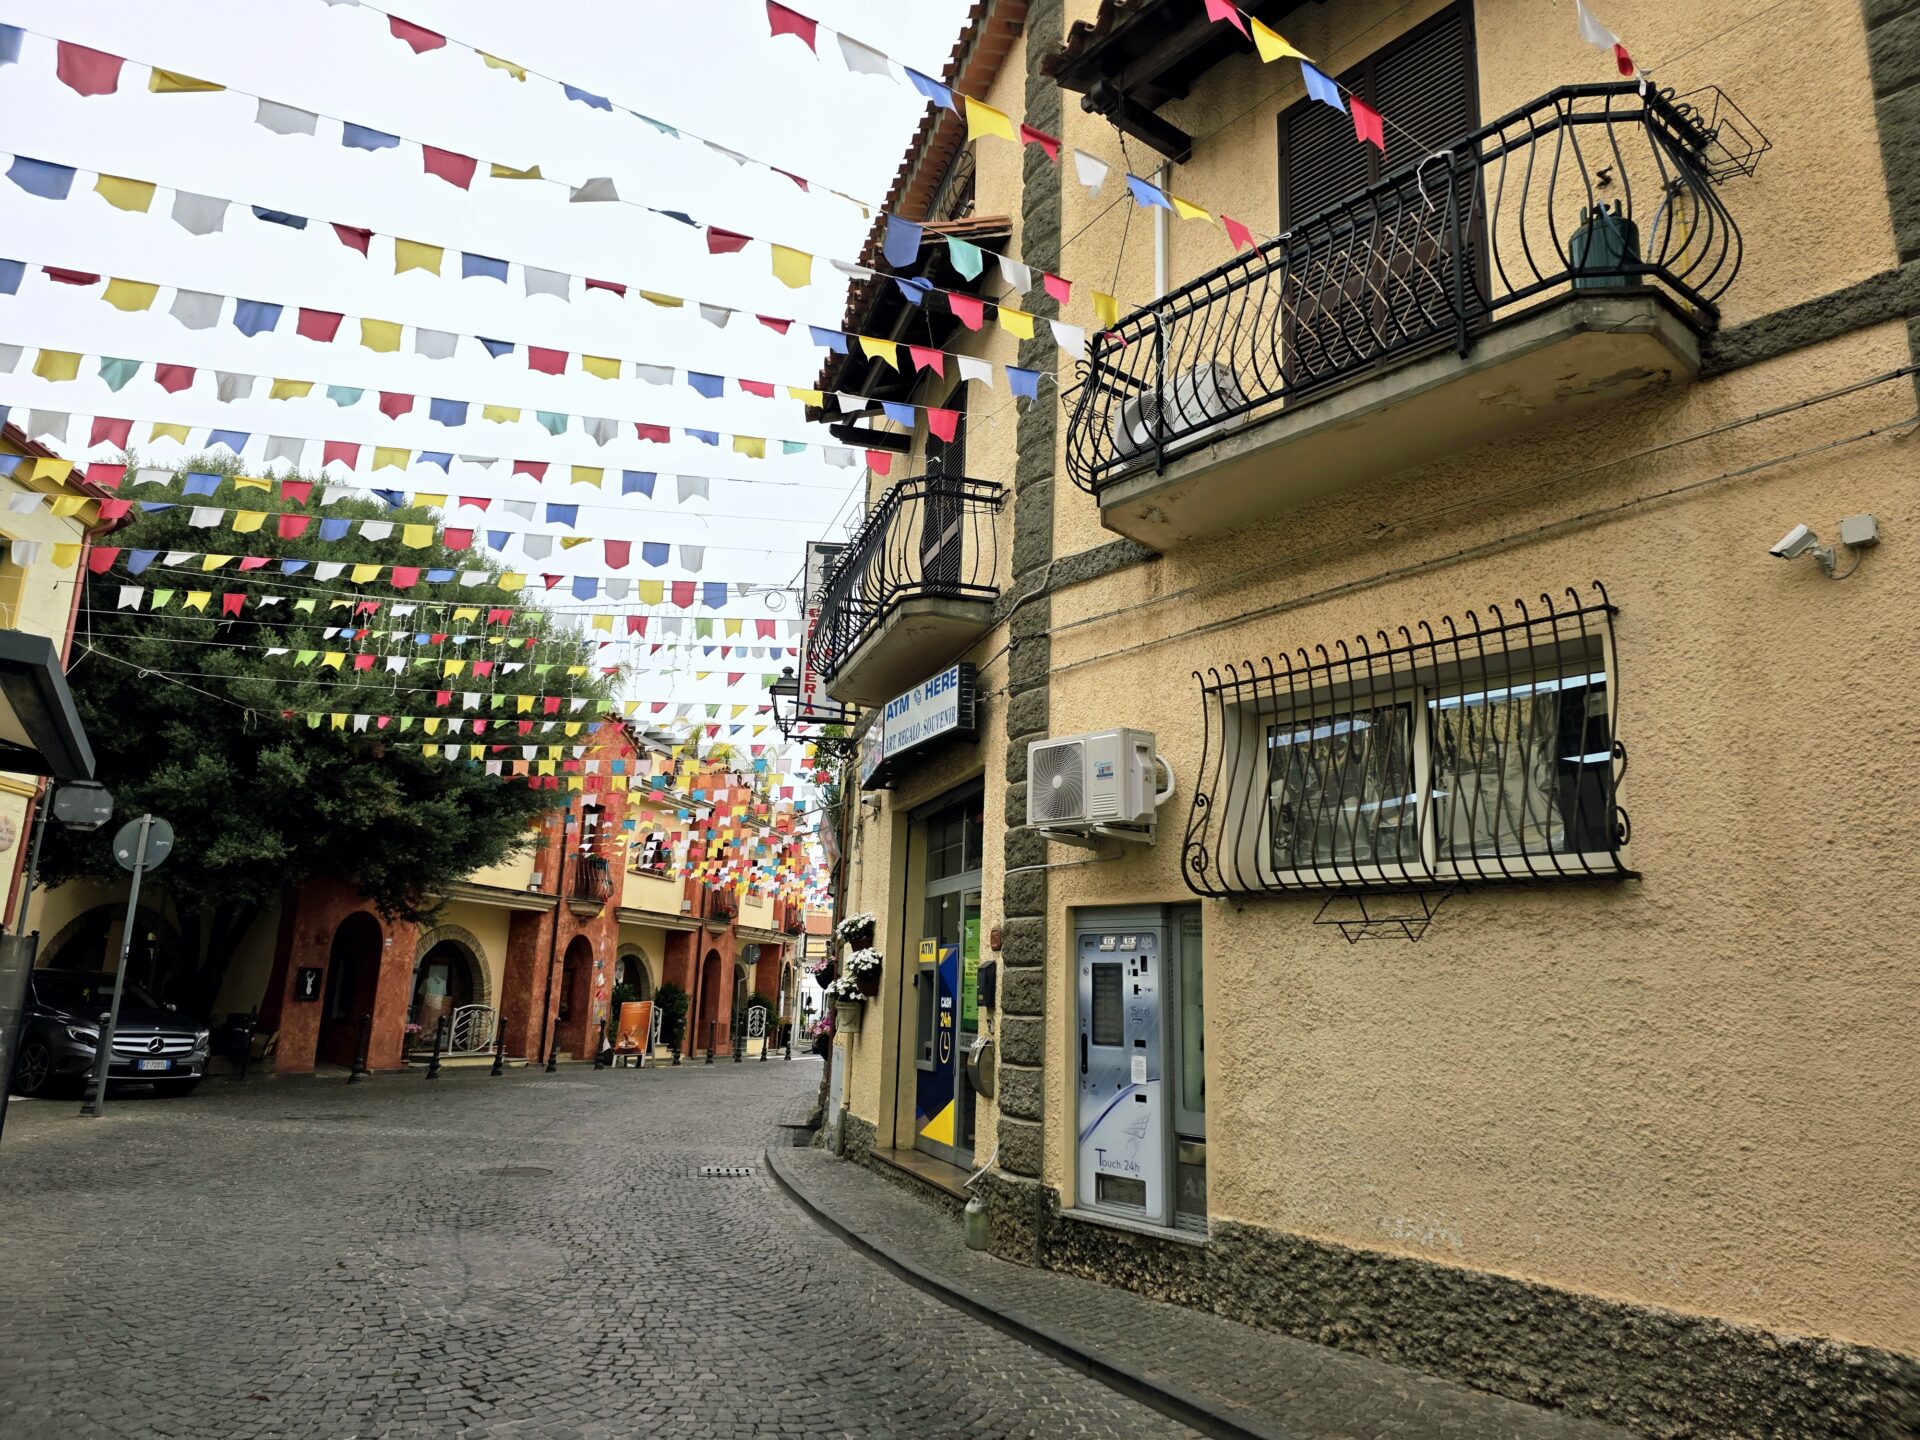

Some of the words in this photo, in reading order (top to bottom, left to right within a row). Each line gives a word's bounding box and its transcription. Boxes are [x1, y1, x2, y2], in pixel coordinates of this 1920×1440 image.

[886, 694, 910, 722] ATM
[925, 668, 958, 701] HERE
[921, 943, 934, 955] ATM
[940, 996, 952, 1008] CASH
[940, 1011, 952, 1028] 24h
[1095, 1148, 1122, 1169] Touch
[1124, 1160, 1140, 1172] 24h
